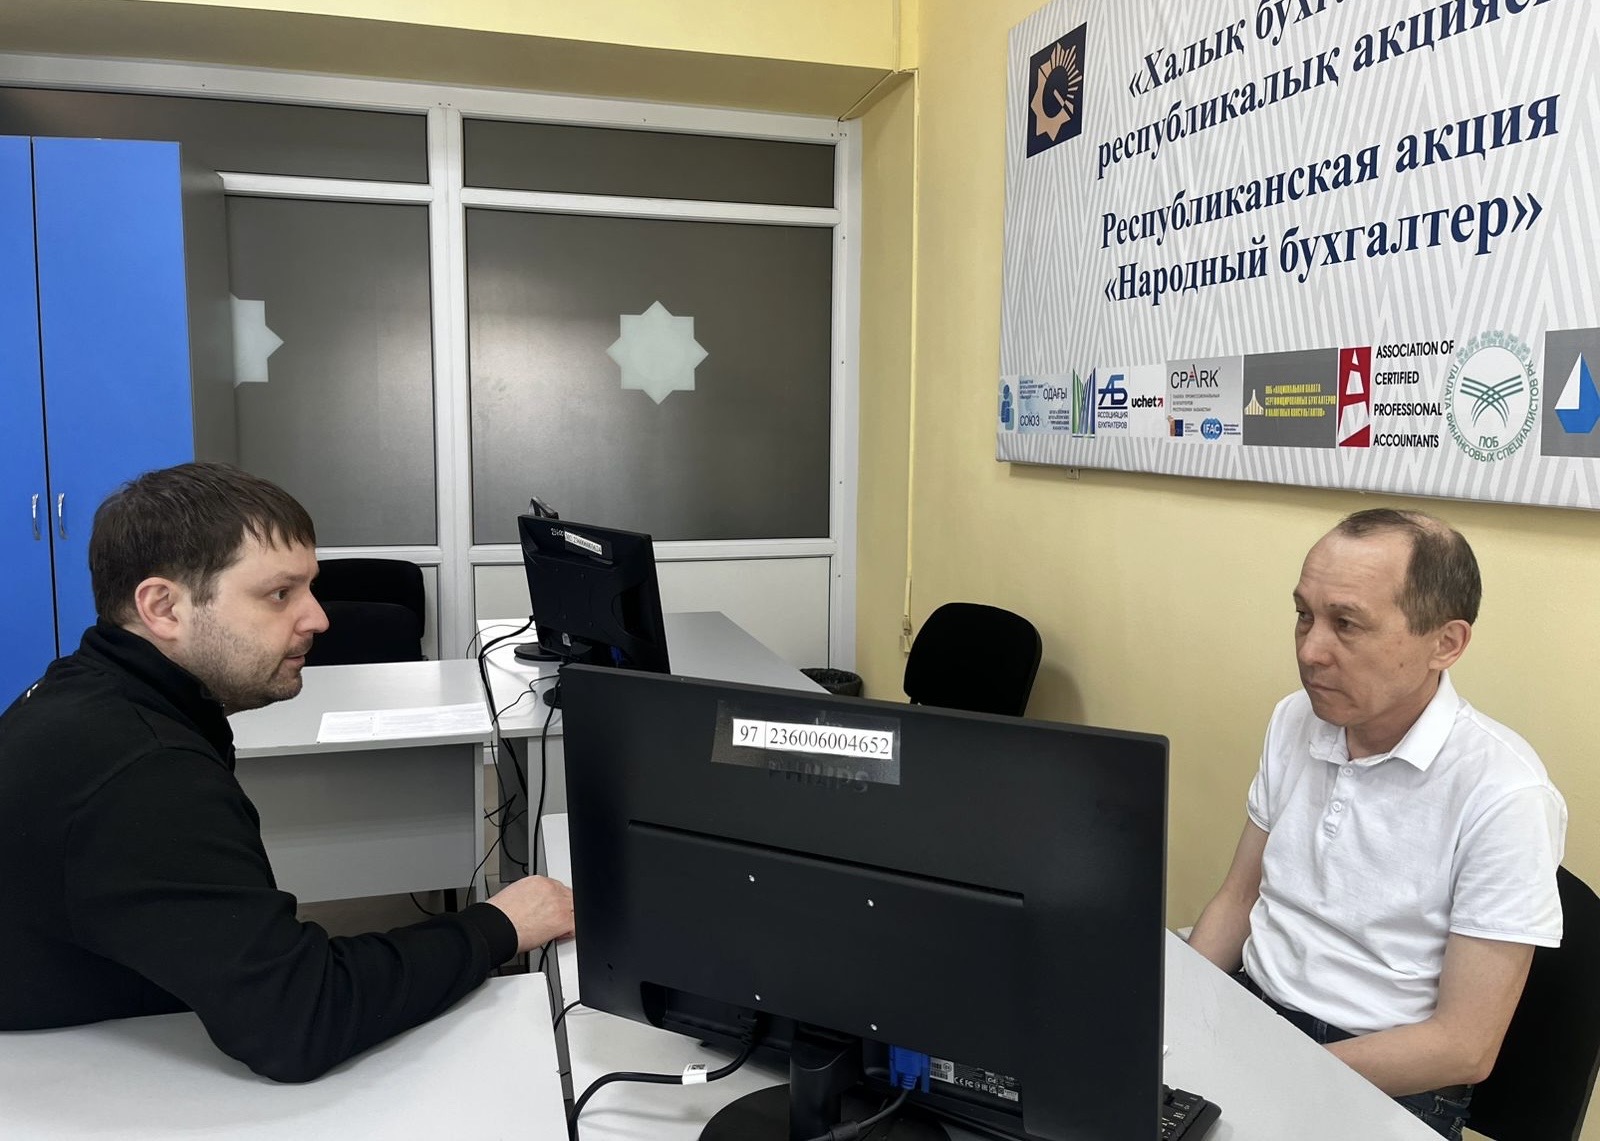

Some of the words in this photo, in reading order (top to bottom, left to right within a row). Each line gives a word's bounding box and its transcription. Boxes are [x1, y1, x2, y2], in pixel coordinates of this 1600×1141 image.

[1128, 18, 1245, 98] «Халық
[1097, 47, 1341, 180] республикалық
[1101, 145, 1382, 249] Республиканская
[1395, 94, 1560, 173] акция
[1104, 234, 1269, 306] «Народный
[1280, 193, 1543, 283] бухгалтер»
[1376, 341, 1438, 358] ASSOCIATION
[1440, 340, 1454, 354] OF
[1170, 364, 1219, 389] CPARK
[1375, 371, 1419, 385] CERTIFIED
[1444, 364, 1459, 410] ПАЛАТА
[1020, 414, 1040, 427] СОЮЗ
[1374, 403, 1442, 416] PROFESSIONAL
[1497, 379, 1539, 461] СПЕЦИАЛИСТОВ
[1203, 424, 1220, 435] IFAC
[1373, 434, 1439, 448] ACCOUNTANTS
[1446, 412, 1495, 462] ФИНАНСОВЫХ
[1479, 436, 1499, 448] ПОБ
[740, 725, 758, 742] 97
[770, 727, 889, 755] 236006004652
